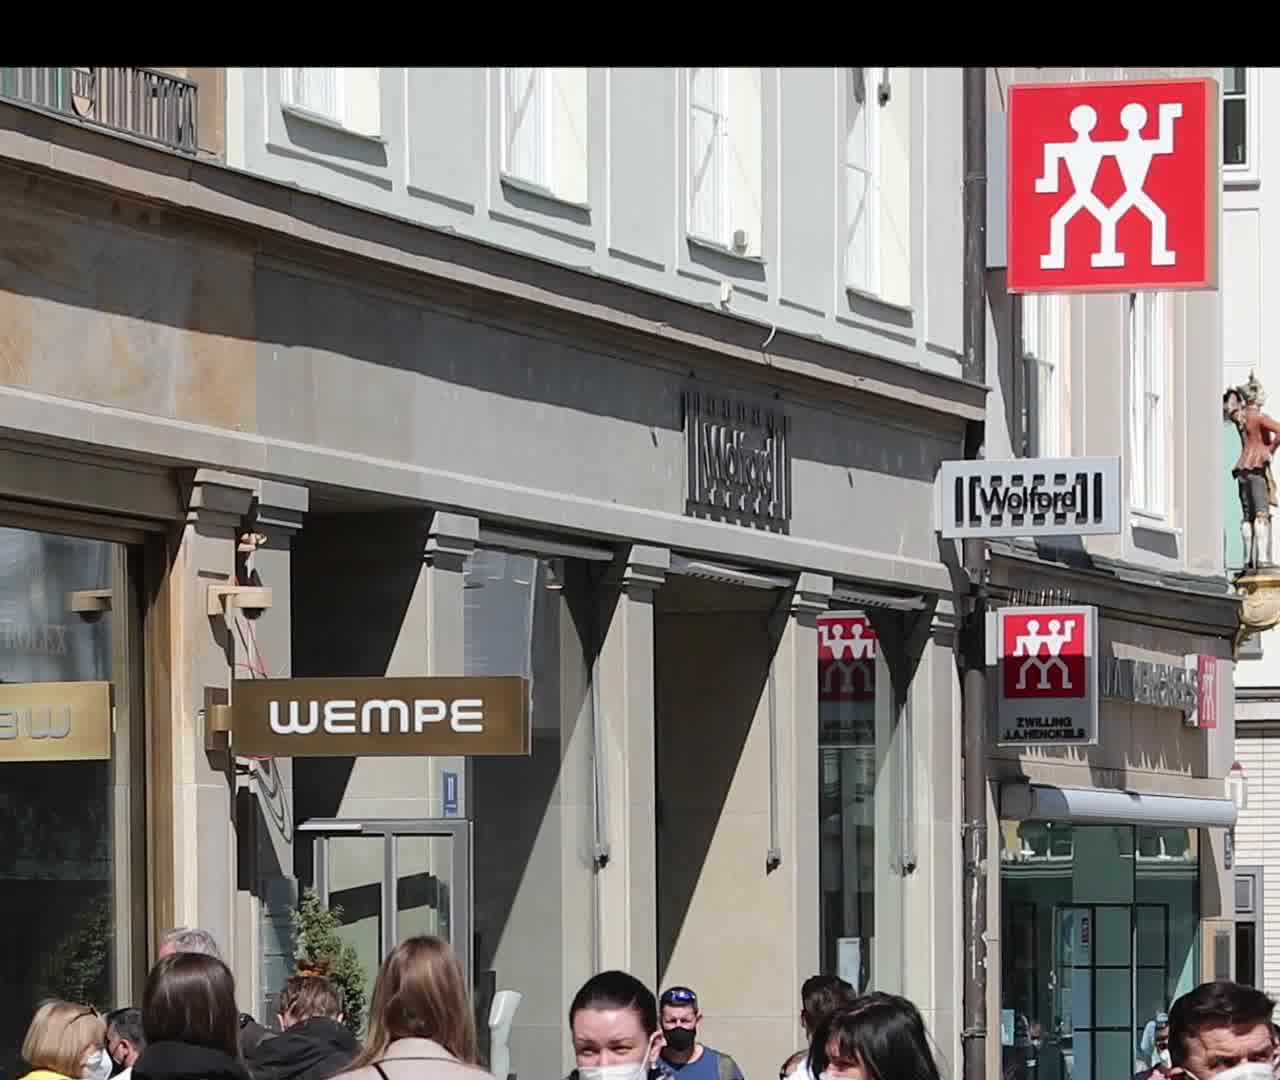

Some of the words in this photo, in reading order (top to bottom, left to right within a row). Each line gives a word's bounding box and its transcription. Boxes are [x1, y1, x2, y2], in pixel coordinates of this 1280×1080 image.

[980, 483, 1077, 515] Wolford
[268, 698, 484, 735] WEMPE
[1015, 716, 1073, 729] ZWILLING
